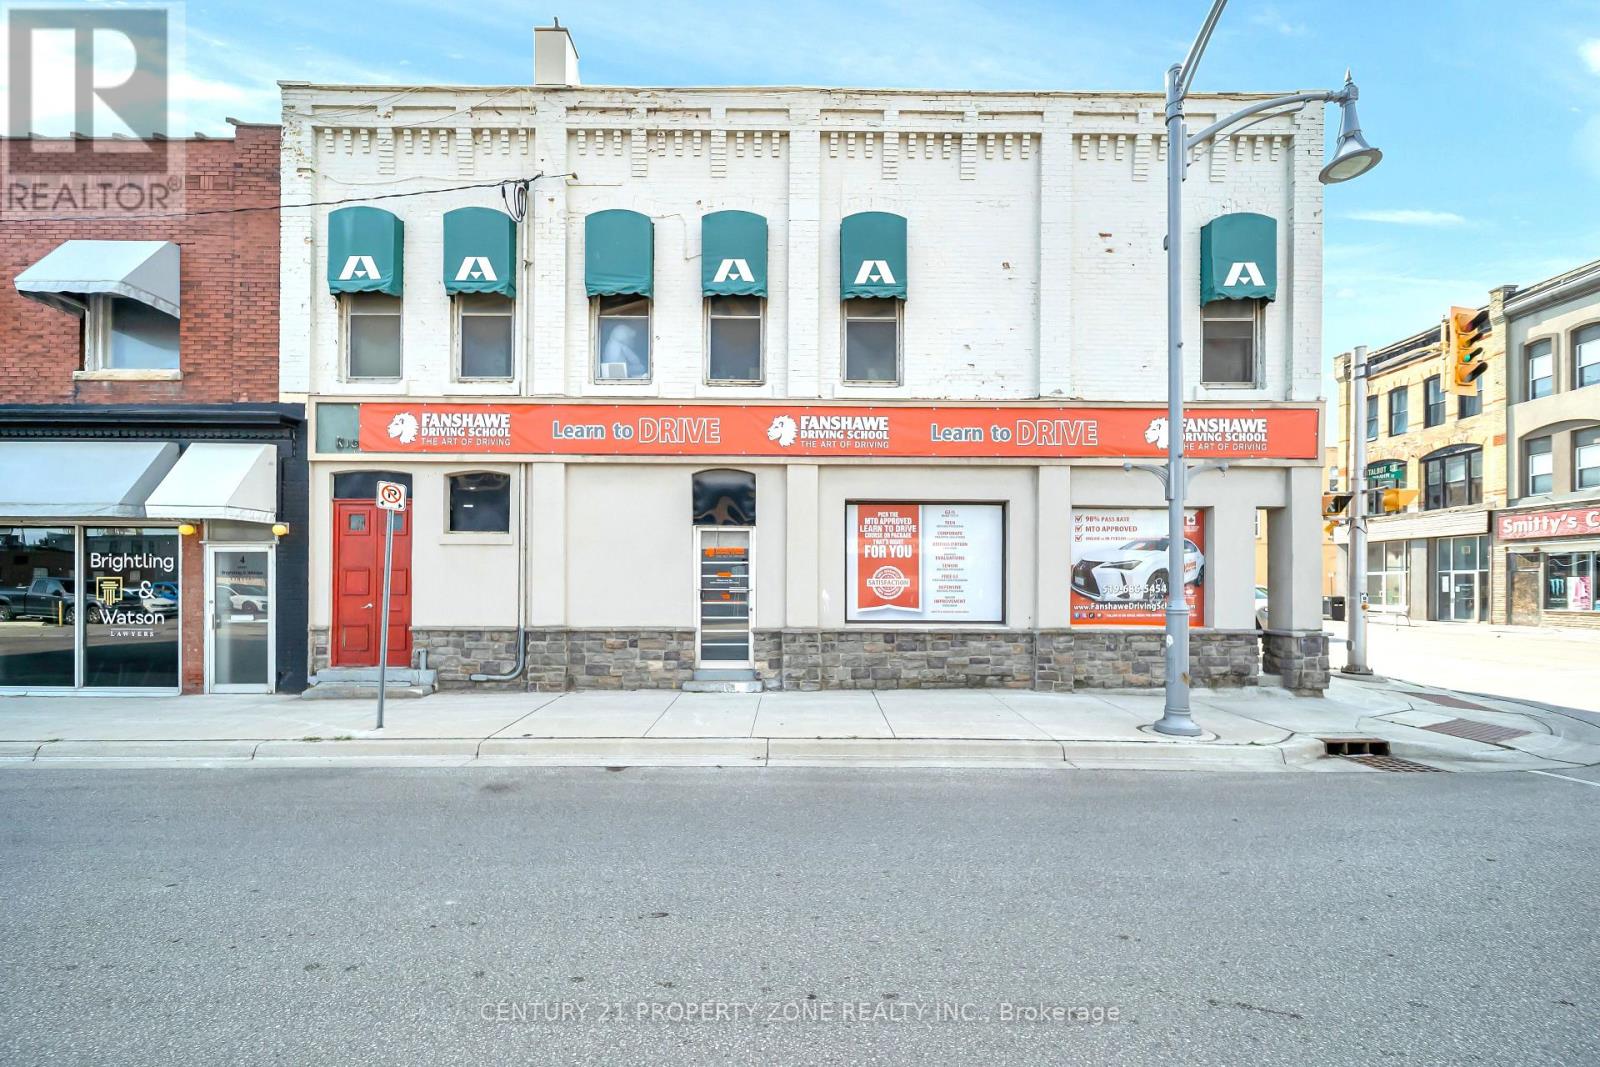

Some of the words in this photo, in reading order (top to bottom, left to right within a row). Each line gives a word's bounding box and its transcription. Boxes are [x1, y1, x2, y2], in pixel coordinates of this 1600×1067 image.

[421, 413, 511, 428] FANSHAWE
[800, 415, 889, 431] FANSHAWE
[1183, 418, 1267, 433] FANSHAWE
[421, 427, 466, 437] DRIVING
[468, 427, 511, 437] SCHOOL
[552, 420, 606, 439] Learn
[613, 422, 634, 439] to
[638, 417, 721, 444] DRIVE
[800, 430, 844, 439] DRIVING
[847, 430, 889, 440] SCHOOL
[931, 422, 984, 442] Learn
[990, 424, 1012, 442] to
[1016, 419, 1098, 446] DRIVE
[1224, 432, 1267, 442] SCHOOL
[421, 437, 438, 446] THE
[441, 437, 458, 446] ART
[461, 437, 472, 446] OF
[476, 437, 511, 446] DRIVING
[800, 440, 817, 448] THE
[820, 440, 837, 448] ART
[839, 440, 851, 449] OF
[854, 440, 889, 449] DRIVING
[1183, 442, 1195, 451] HE
[1198, 442, 1214, 451] ART
[1217, 442, 1229, 451] OF
[1232, 442, 1267, 451] DRIVING
[864, 517, 879, 525] MTO
[880, 517, 912, 525] APPROVED
[1502, 513, 1577, 534] Smitty's
[895, 525, 917, 533] DRIVE
[864, 544, 886, 559] FOR
[889, 544, 913, 559] YOU
[90, 552, 174, 572] Brightling
[139, 580, 156, 599] &
[1102, 583, 1167, 594] 519-686-5454
[99, 609, 165, 625] Watson
